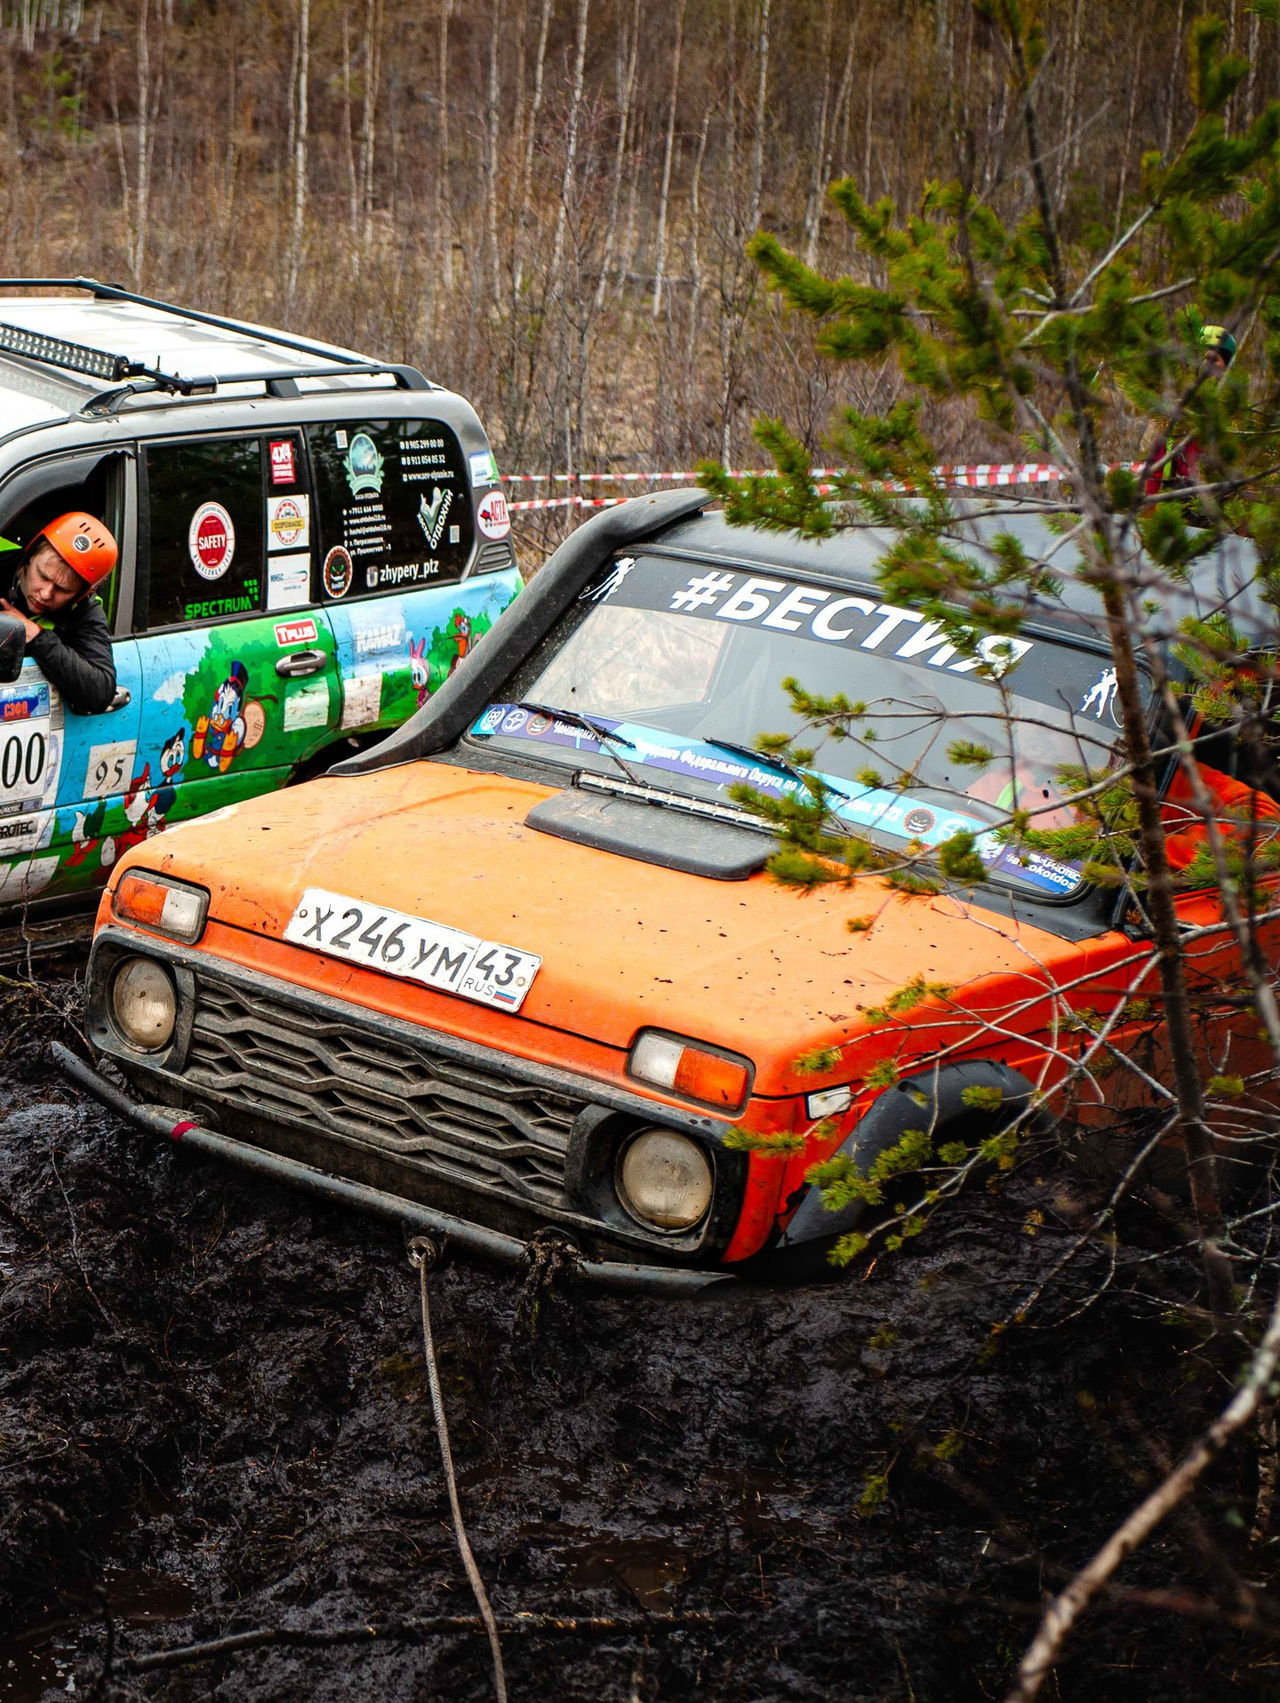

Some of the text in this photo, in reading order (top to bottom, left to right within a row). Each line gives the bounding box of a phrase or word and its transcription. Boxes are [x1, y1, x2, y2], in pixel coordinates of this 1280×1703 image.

[430, 488, 454, 549] ОТДОХНИ
[199, 534, 226, 550] SAFETY
[380, 559, 439, 582] zhypery_ptz
[185, 596, 253, 619] SPECTRUM
[669, 570, 1034, 681] #БЕСТИЯ
[3, 700, 28, 718] СЗФО
[95, 757, 126, 791] 95
[679, 749, 751, 778] Федерального
[749, 767, 784, 788] Округа
[783, 779, 798, 791] по
[1005, 852, 1076, 891] #aokotdos
[475, 949, 522, 986] 43
[463, 976, 496, 997] RUS
